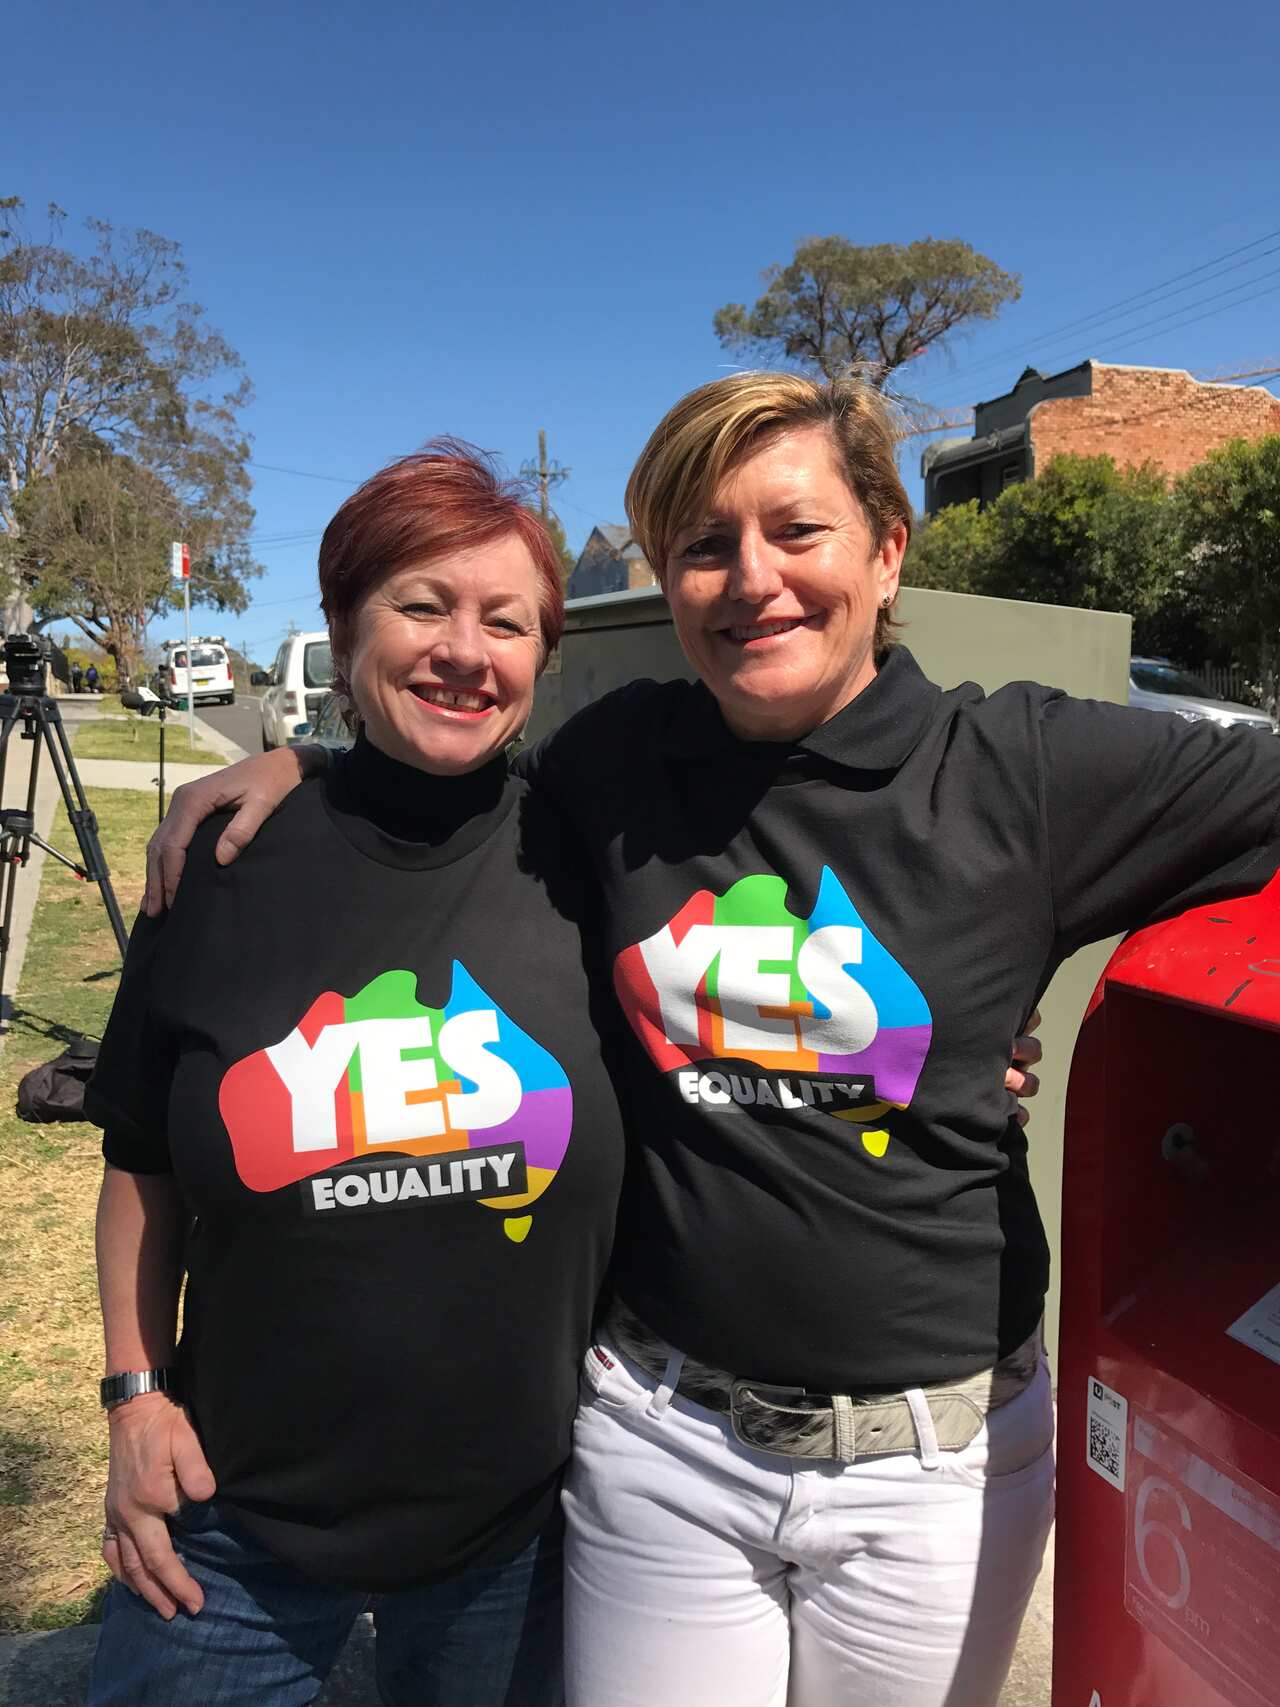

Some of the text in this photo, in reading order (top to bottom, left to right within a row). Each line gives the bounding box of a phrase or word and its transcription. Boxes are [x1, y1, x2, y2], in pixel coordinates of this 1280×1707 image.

[639, 925, 878, 1055] YES
[264, 1009, 523, 1153] YES
[678, 1071, 865, 1109] EQUALITY
[311, 1152, 516, 1211] EQUALITY
[1135, 1476, 1191, 1608] 6
